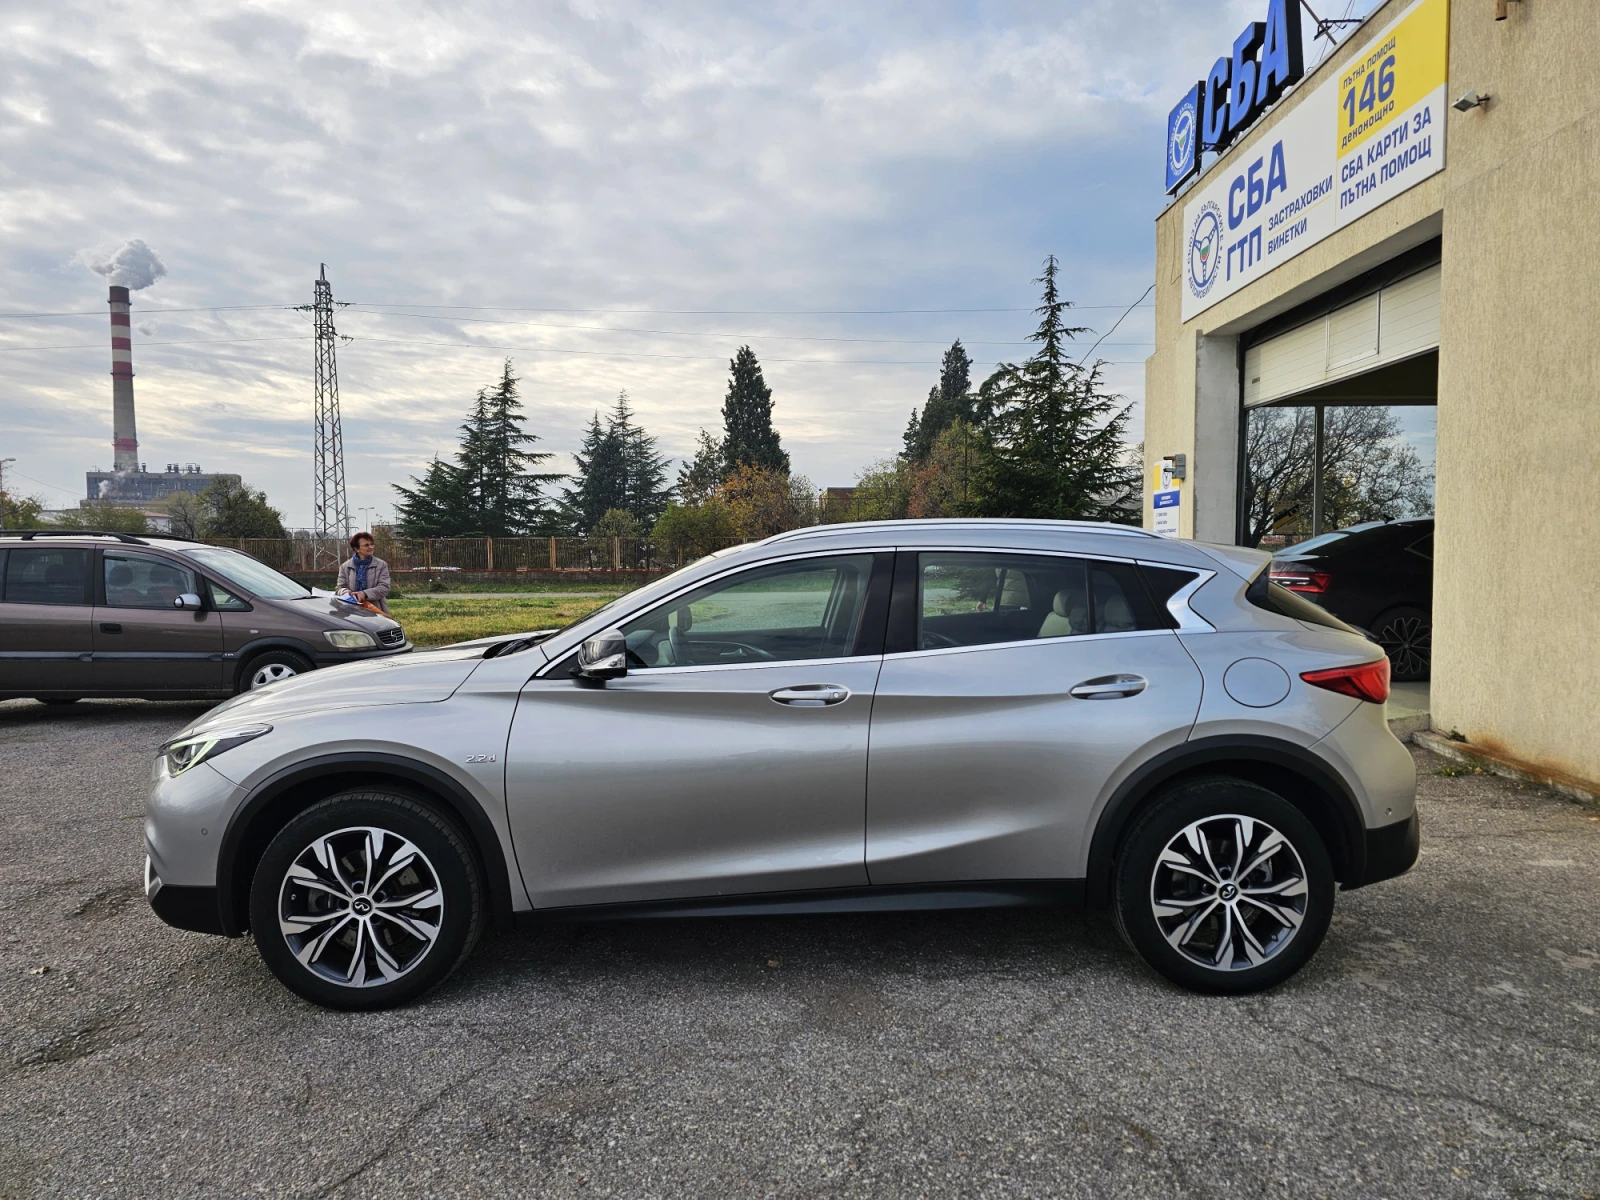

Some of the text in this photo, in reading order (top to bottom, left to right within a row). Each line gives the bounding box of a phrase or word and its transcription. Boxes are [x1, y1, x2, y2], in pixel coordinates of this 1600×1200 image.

[1202, 0, 1290, 152] СБА
[1342, 54, 1396, 128] 146
[1343, 36, 1396, 90] ПЪТНА ПОМОЩ
[1341, 99, 1395, 149] денонощно
[1341, 105, 1432, 183] СБА КАРТИ ЗА
[1227, 139, 1288, 231] СБА
[1268, 174, 1333, 232] ЗАСТРАХОВКИ
[1340, 134, 1432, 210] ПЪТНА ПОМОЩ
[1226, 224, 1262, 282] ГТП
[1267, 217, 1307, 255] ВИНЕТКИ
